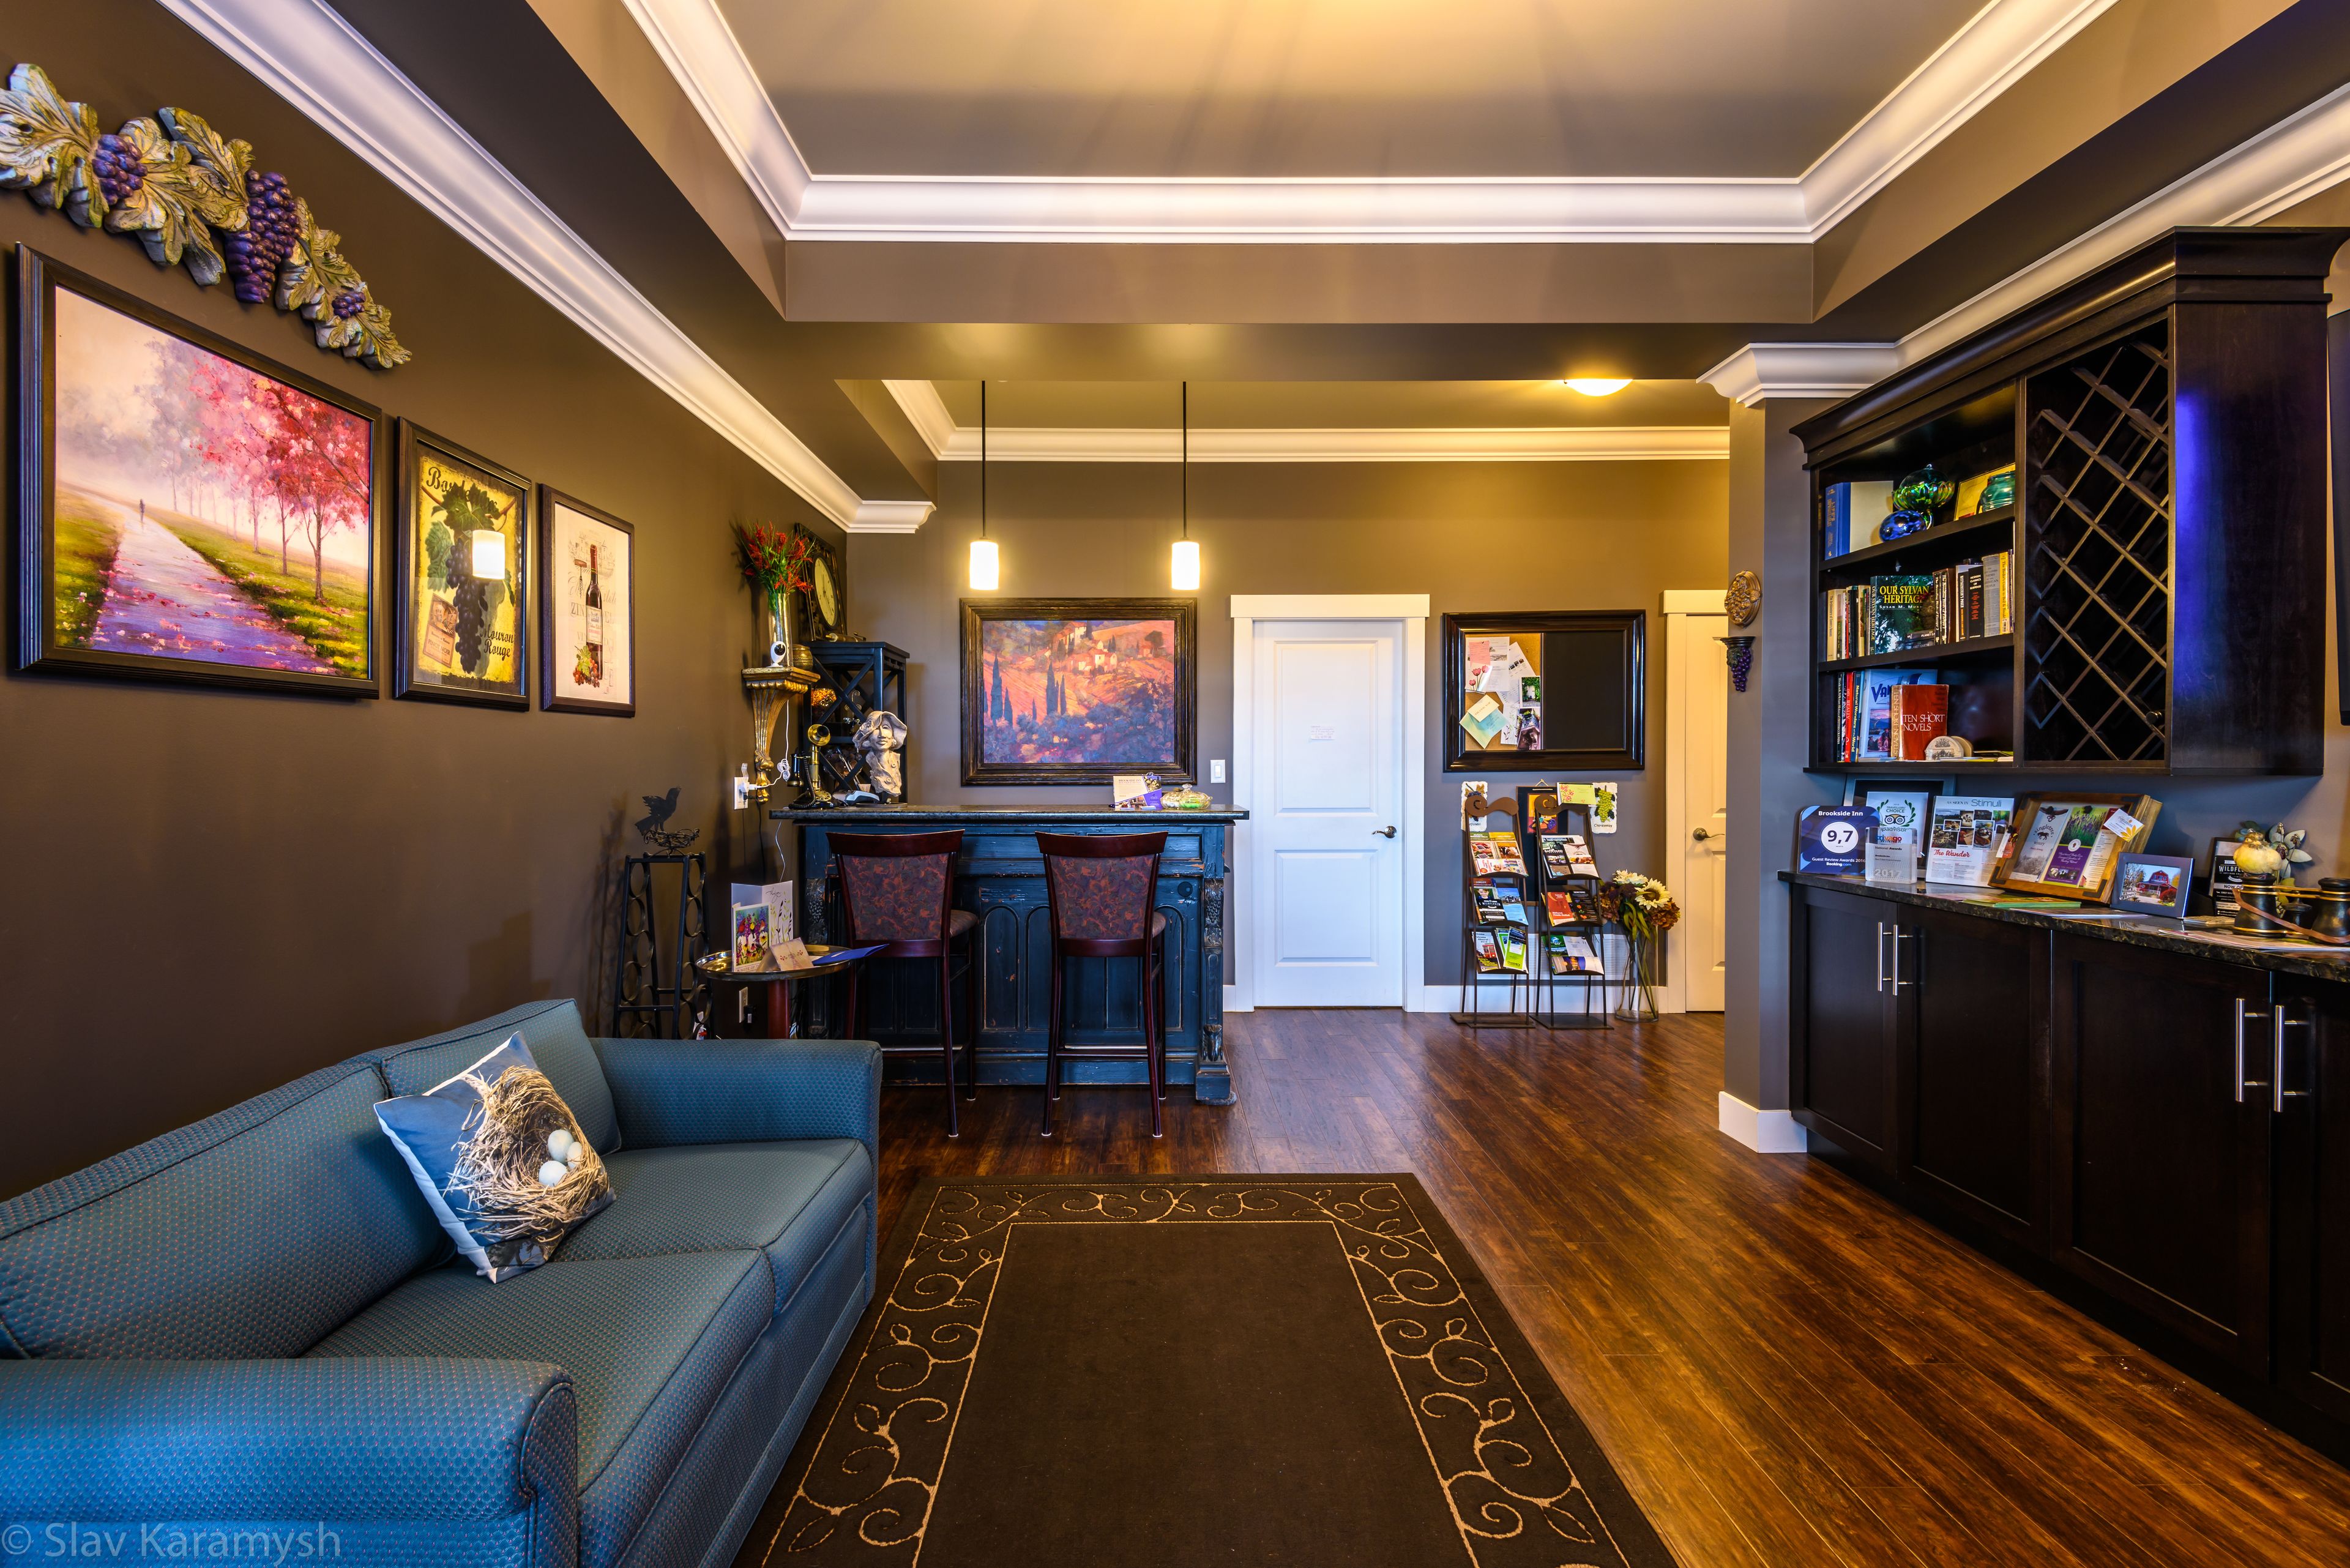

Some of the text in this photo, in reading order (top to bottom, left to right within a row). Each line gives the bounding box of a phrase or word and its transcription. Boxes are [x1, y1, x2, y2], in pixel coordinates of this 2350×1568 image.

[1879, 586, 1930, 595] OUR SYLVAN
[483, 639, 511, 662] Rouge
[1903, 713, 1945, 723] TEN SHORT
[1903, 723, 1931, 731] NOVELS
[1971, 799, 2002, 807] Stimuli
[1827, 830, 1854, 844] 9,7
[1874, 868, 1902, 878] 2017
